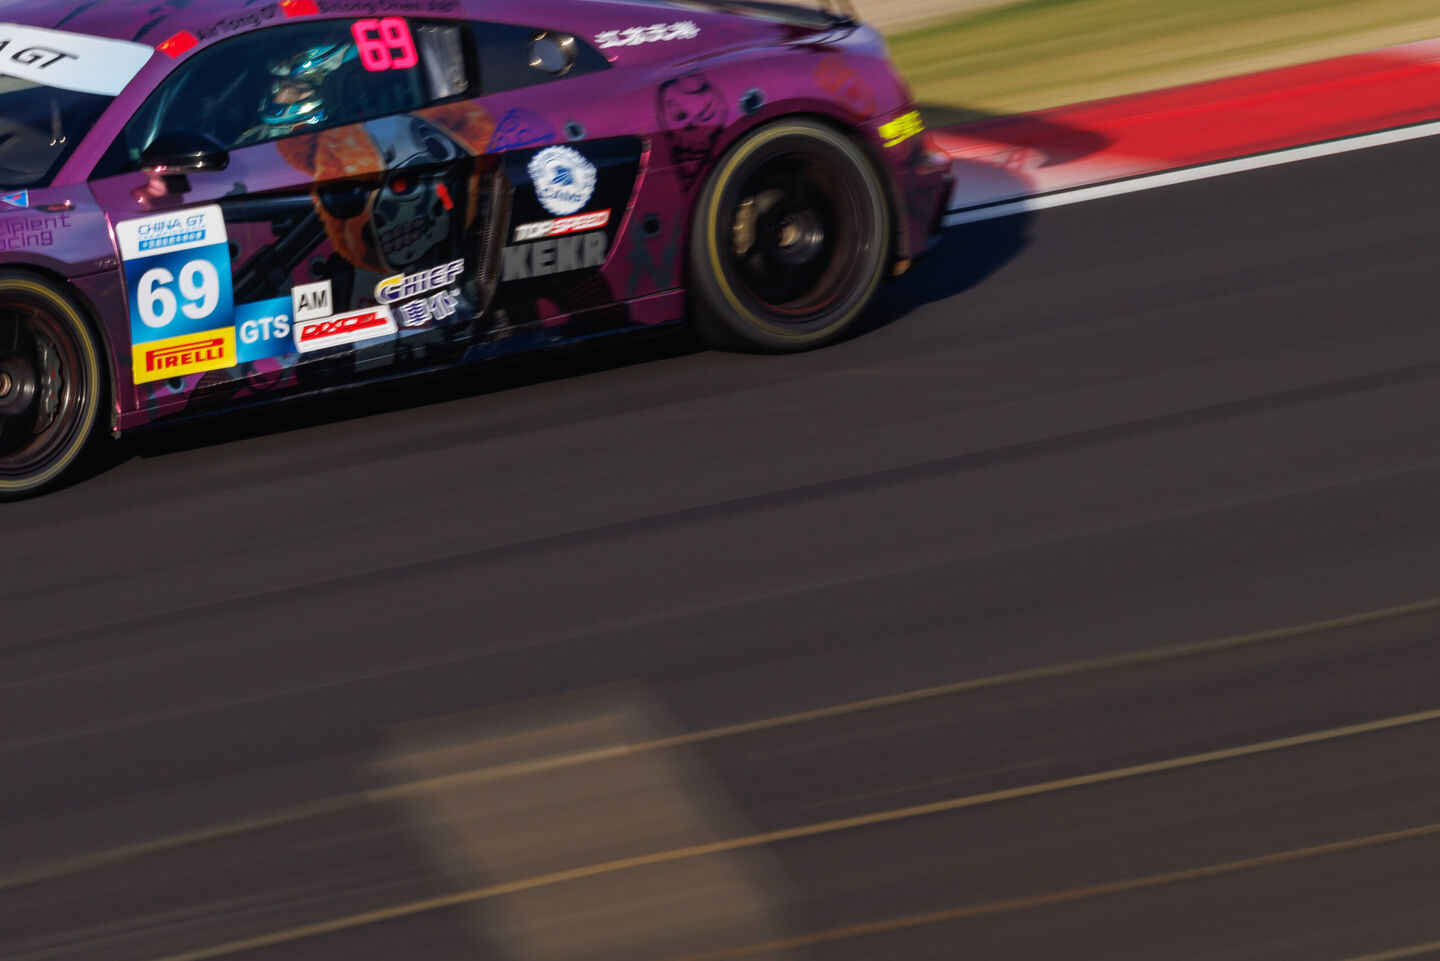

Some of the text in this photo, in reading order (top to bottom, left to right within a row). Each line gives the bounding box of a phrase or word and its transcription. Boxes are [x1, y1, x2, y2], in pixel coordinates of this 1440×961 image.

[11, 46, 79, 69] GT
[351, 16, 418, 71] 69
[138, 214, 205, 236] CHINA GT
[137, 259, 220, 328] 69
[375, 259, 464, 304] CHIEF
[298, 290, 328, 312] AM
[240, 314, 290, 344] GTS
[145, 338, 225, 372] PIRELLI
